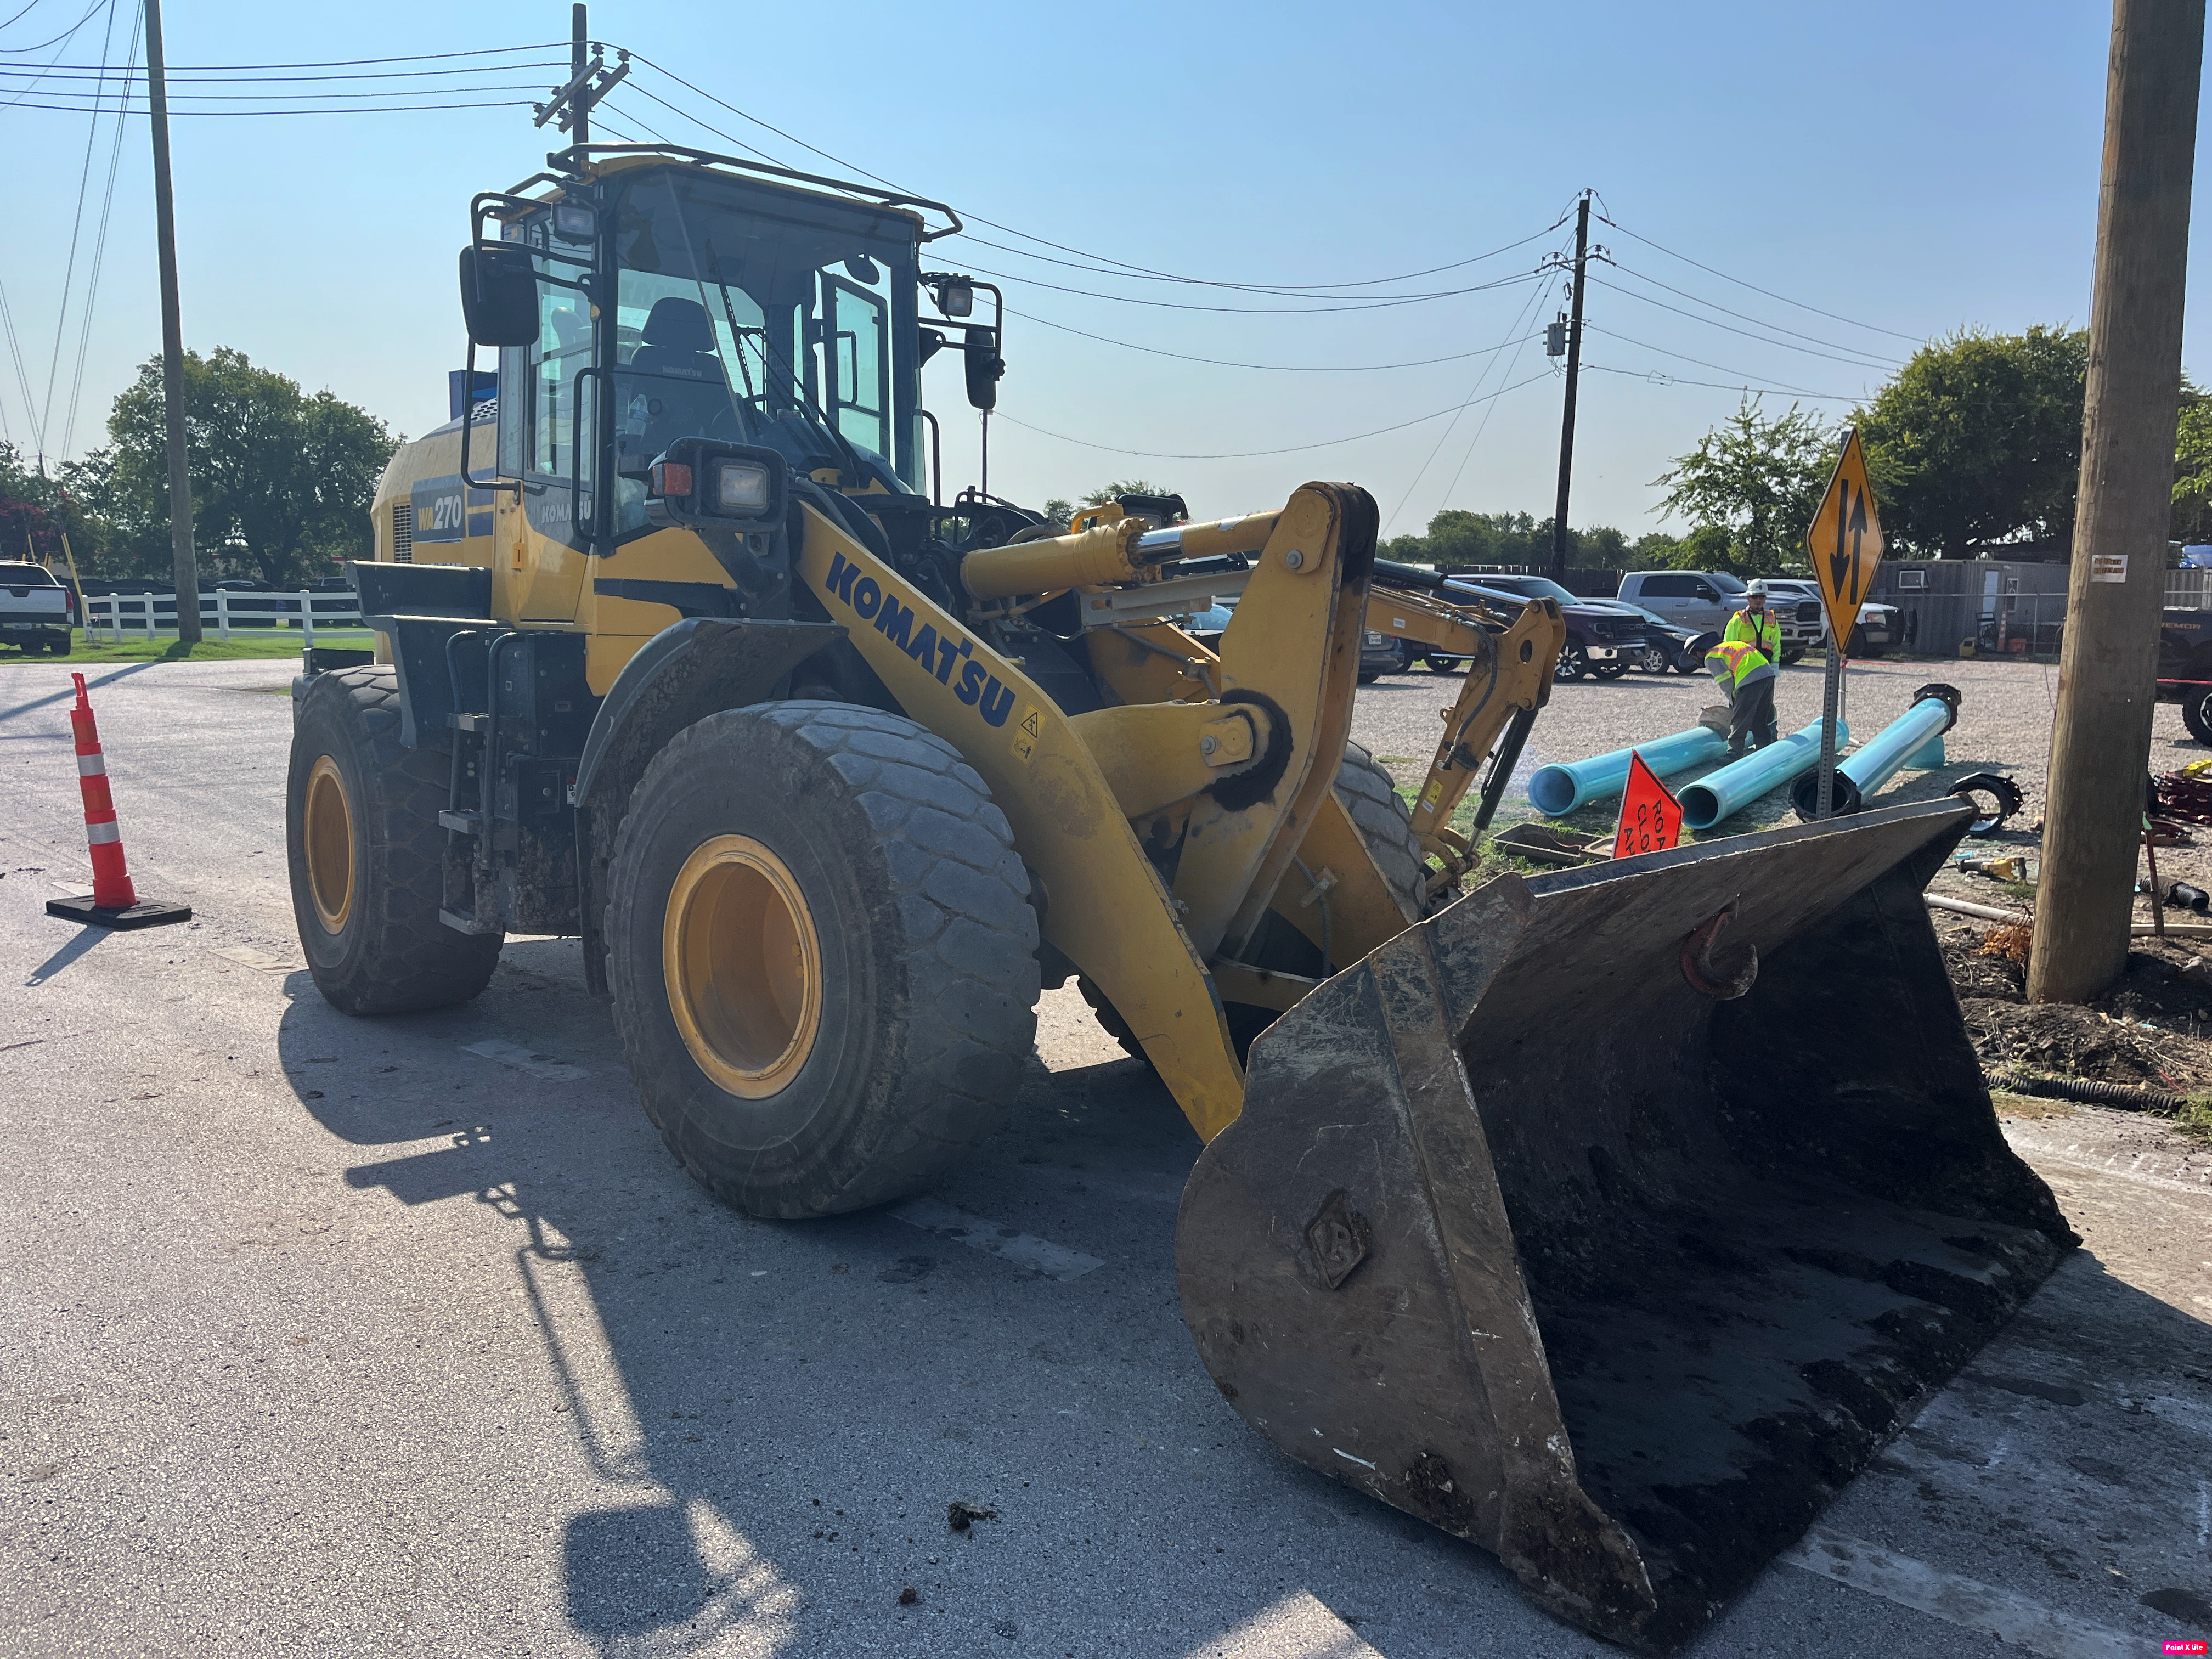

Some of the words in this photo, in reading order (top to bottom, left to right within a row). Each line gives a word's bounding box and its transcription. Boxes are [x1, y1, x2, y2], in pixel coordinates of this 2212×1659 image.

[418, 495, 462, 532] WA270
[541, 500, 591, 523] KOMASU
[825, 551, 1017, 728] KOMATSU
[1638, 803, 1651, 852] CLO
[1652, 798, 1666, 850] ROA
